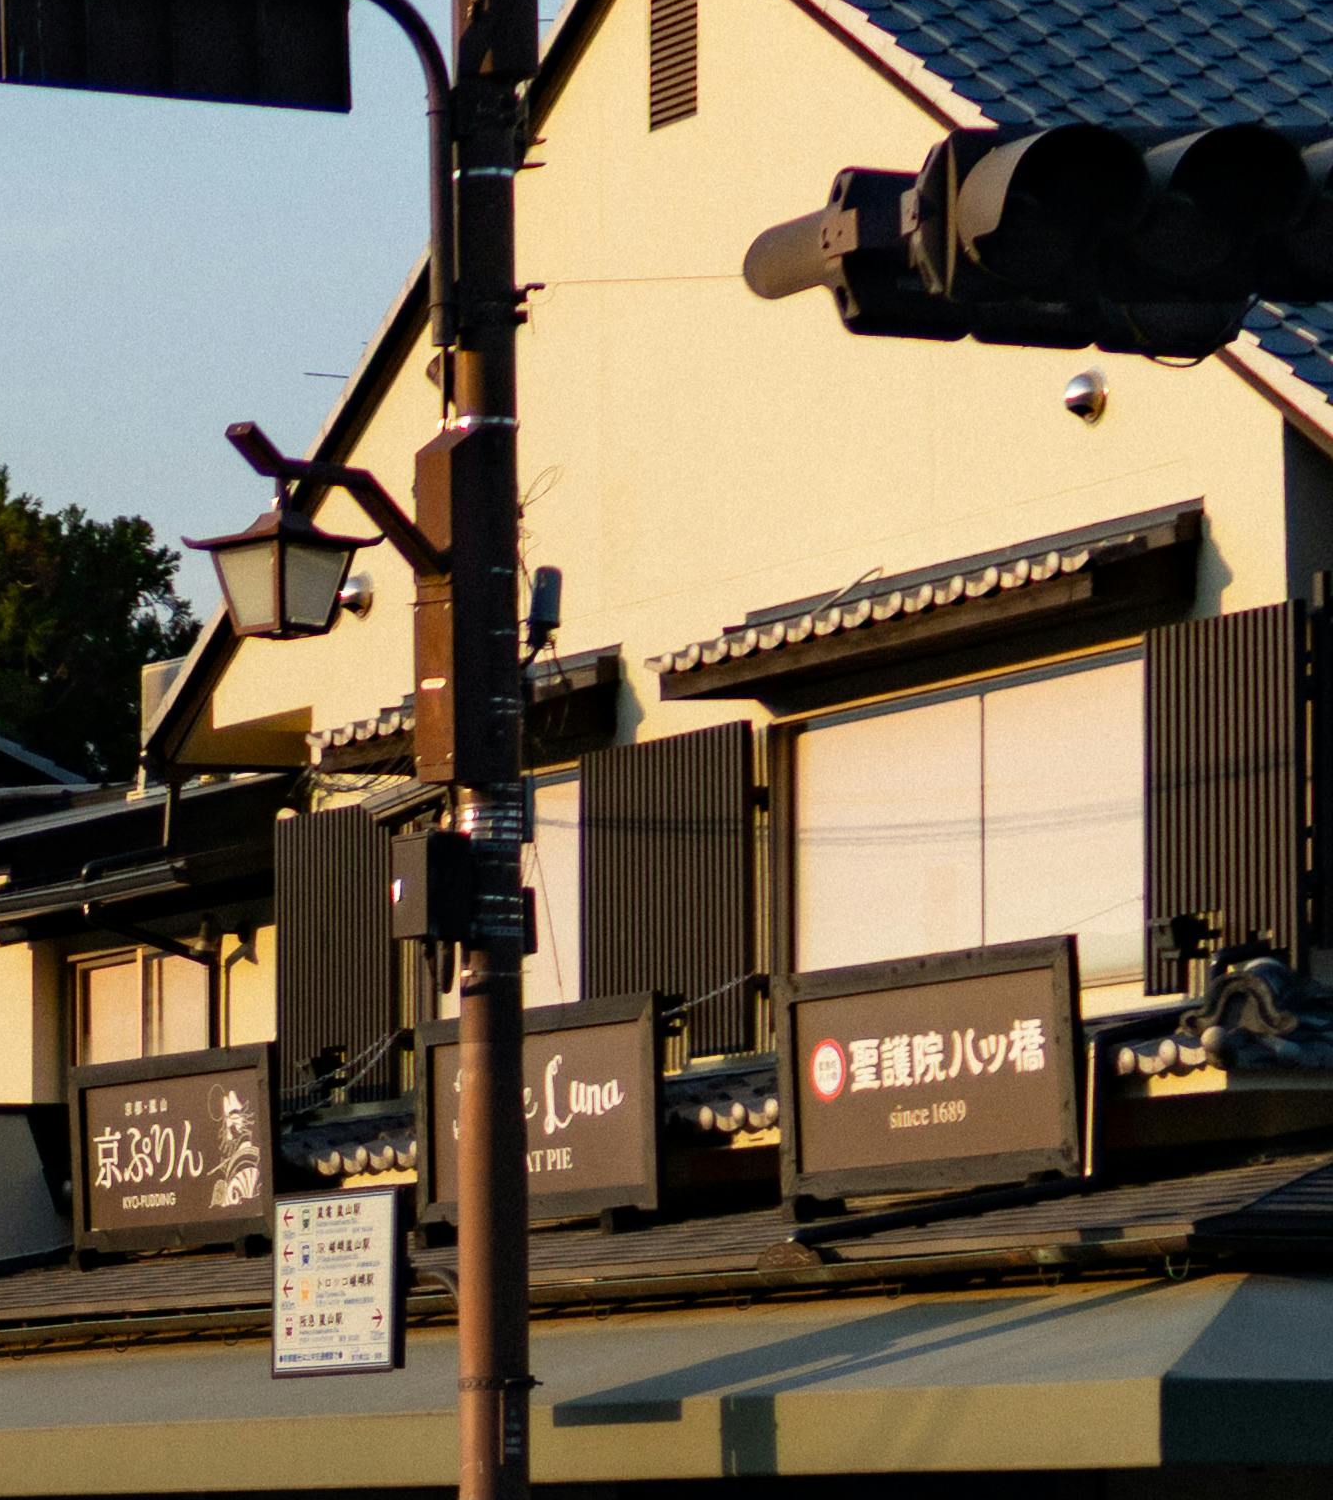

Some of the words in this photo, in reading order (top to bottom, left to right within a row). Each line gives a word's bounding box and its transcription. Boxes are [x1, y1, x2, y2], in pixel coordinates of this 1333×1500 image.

[543, 1054, 625, 1135] Luna
[889, 1105, 929, 1129] since
[932, 1100, 967, 1126] 1689
[92, 1119, 204, 1190] 京ぷりん
[546, 1147, 573, 1171] PIE
